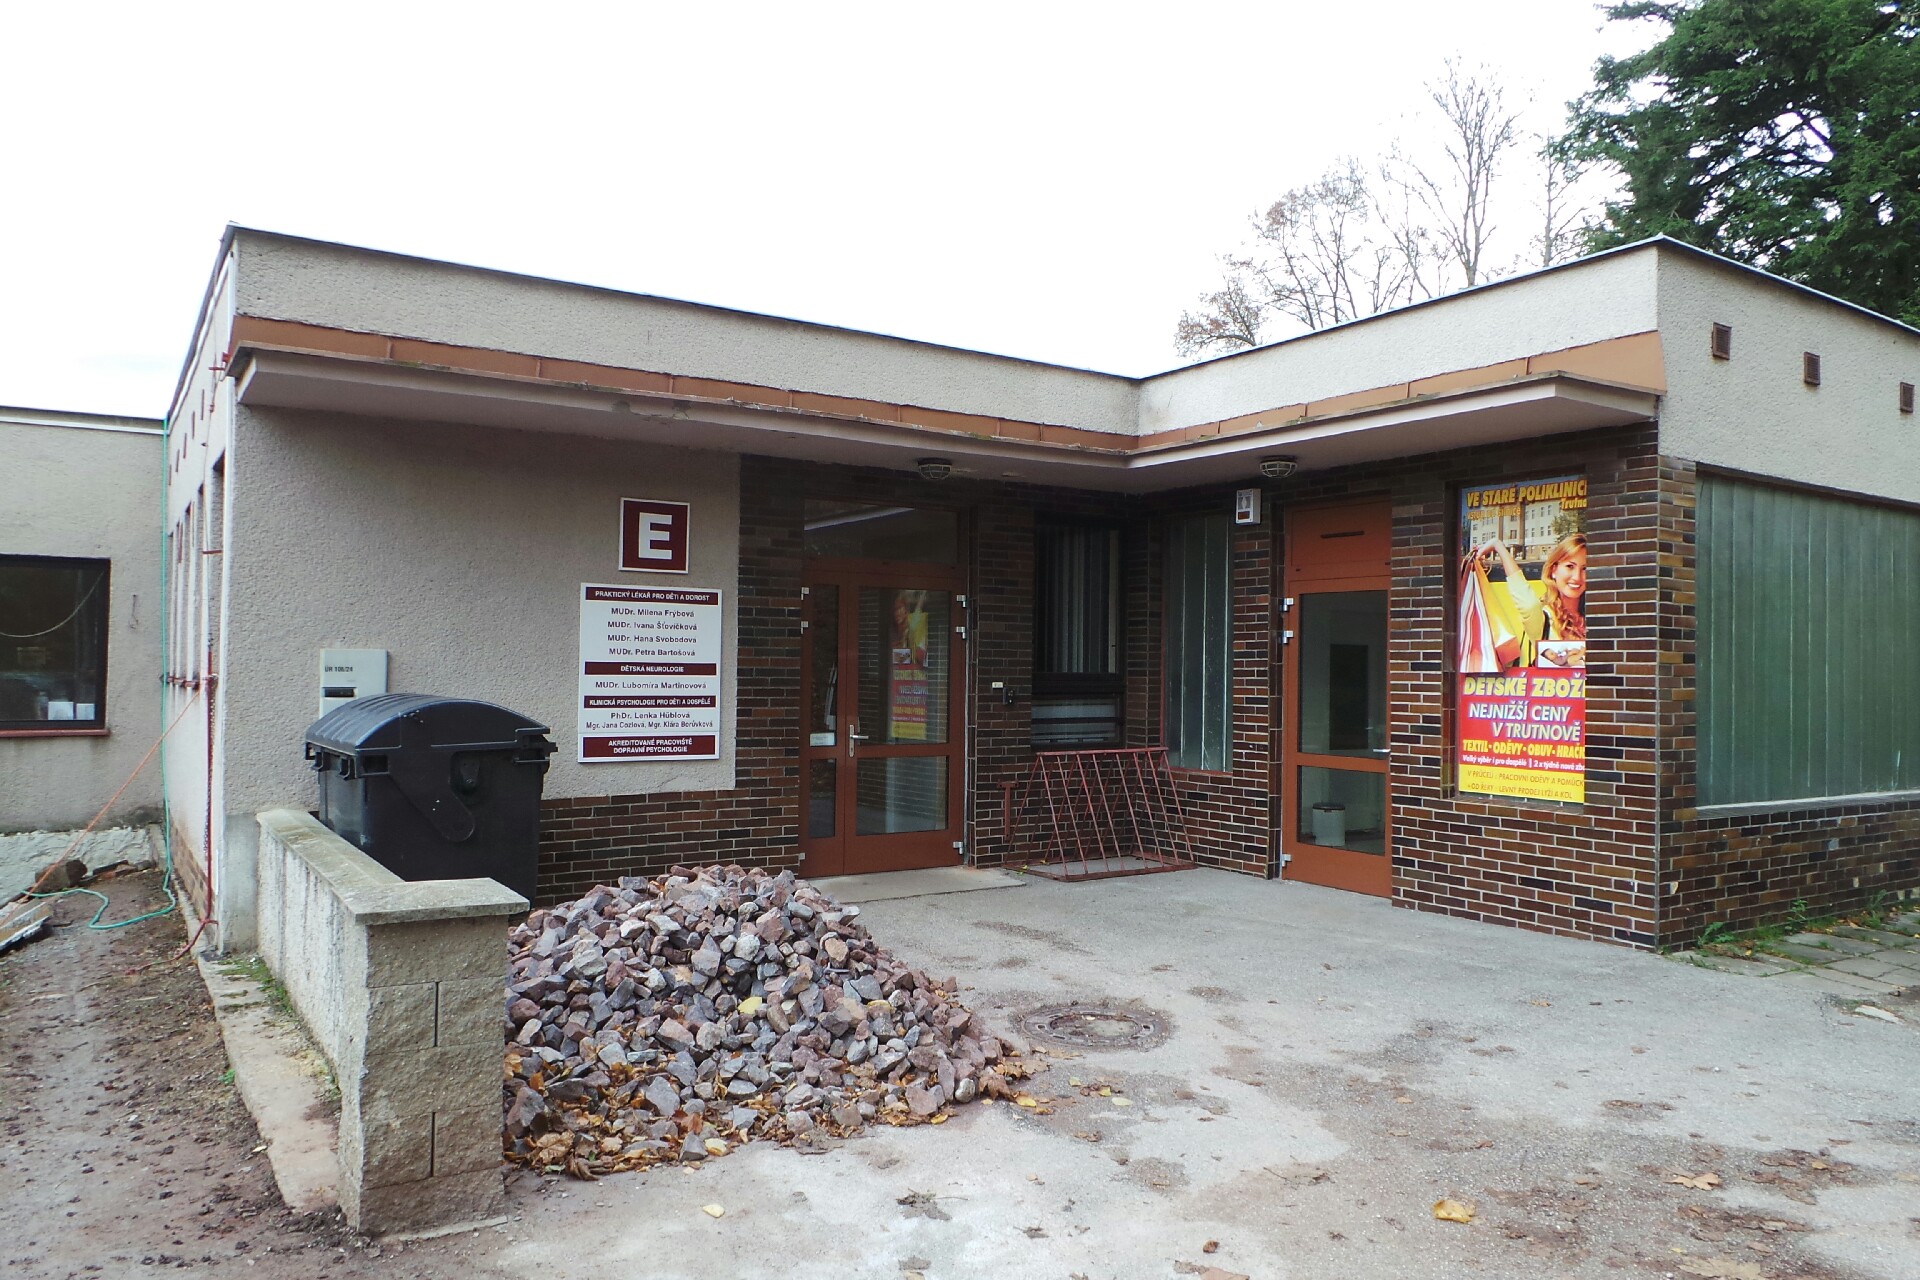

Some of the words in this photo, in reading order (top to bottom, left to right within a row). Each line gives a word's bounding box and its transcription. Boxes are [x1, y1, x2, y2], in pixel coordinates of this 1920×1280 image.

[1467, 492, 1480, 507] VE
[1482, 485, 1516, 506] STARÉ
[638, 512, 673, 560] E
[595, 590, 630, 598] PRAKTICKÝ
[666, 592, 679, 600] DĚTI
[664, 610, 695, 618] Frýbová
[620, 664, 645, 672] DĚTSKÁ
[589, 698, 615, 706] KLINICKÁ
[1469, 700, 1529, 720] NEJNIŽŠÍ
[1531, 705, 1571, 722] CENY
[586, 722, 600, 730] Mgr.
[648, 721, 661, 729] Mgr.
[664, 720, 680, 728] Klára
[681, 720, 713, 728] Borůvková
[1492, 722, 1503, 737] V
[1506, 720, 1581, 742] TRUTNOVĚ
[608, 738, 655, 746] AKREDITOVANÉ
[656, 738, 692, 746] PRACOVIŠTĚ
[613, 746, 645, 754] DOPRAVNÍ
[1463, 739, 1488, 753] TEXTIL
[1493, 740, 1523, 755] ODĚVY
[1527, 743, 1553, 756] OBUV
[1463, 754, 1477, 763] Velký
[1477, 755, 1492, 764] výběr
[1506, 757, 1527, 767] dospělé
[1543, 760, 1559, 769] týdně
[1499, 772, 1529, 781] PRACOVNÍ
[1529, 774, 1550, 783] ODĚVY
